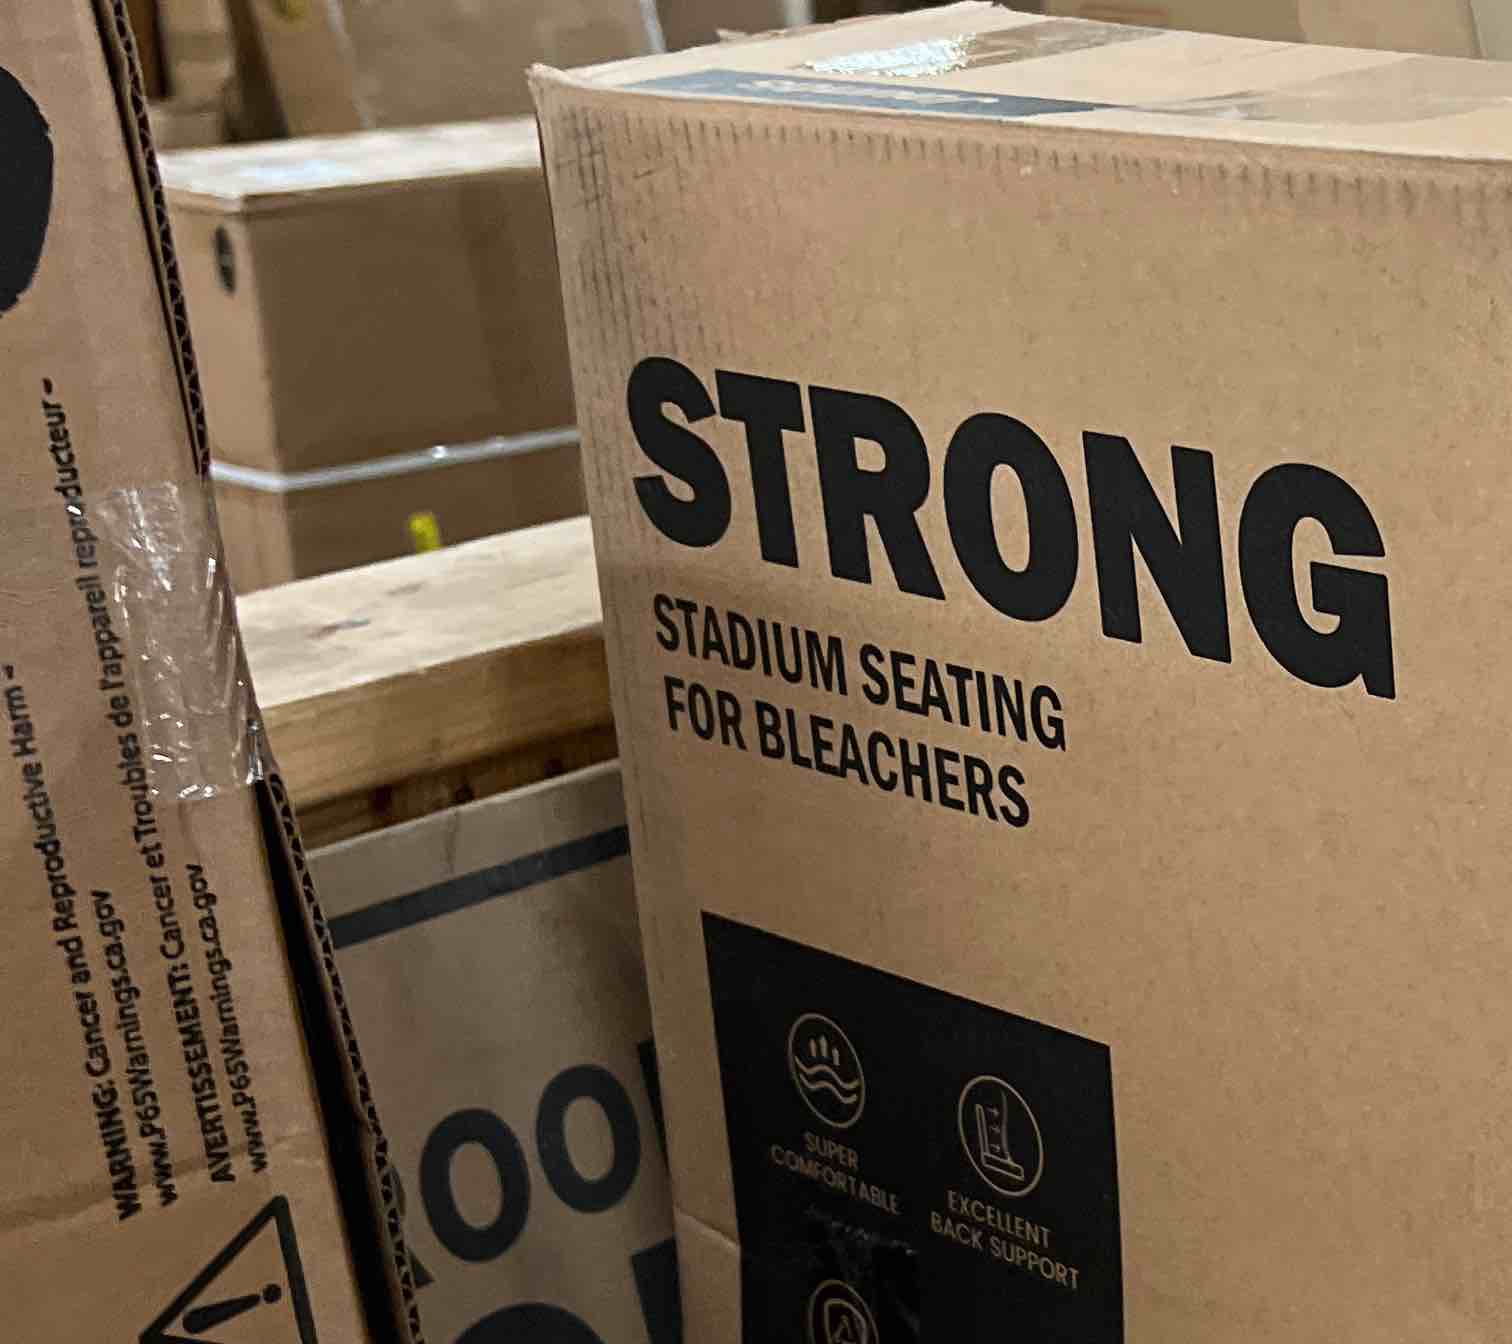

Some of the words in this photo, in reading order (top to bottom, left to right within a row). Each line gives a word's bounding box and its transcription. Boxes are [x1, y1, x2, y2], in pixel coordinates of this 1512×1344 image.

[41, 398, 99, 570] reproducteur
[625, 355, 1397, 700] STRONG
[2, 685, 38, 758] Harm
[105, 694, 135, 730] de
[653, 592, 848, 697] STADIUM
[860, 642, 1067, 753] SEATING
[117, 733, 158, 843] Troubles
[664, 676, 746, 748] FOR
[755, 703, 1031, 829] BLEACHERS
[22, 759, 78, 933] Reproductive
[139, 840, 166, 871] et
[57, 934, 92, 987] and
[149, 873, 186, 961] Cancer
[75, 990, 112, 1079] Cancer
[90, 888, 179, 1208] www.P65Warnings.ca.gov
[185, 862, 269, 1174] www.P65Warnings.ca.gov
[166, 965, 236, 1184] AVERTISSEMENT:
[91, 1080, 142, 1222] WARNING:
[769, 1143, 901, 1217] COMFORTABLE
[803, 1130, 860, 1170] SUPER
[929, 1211, 983, 1250] BACK
[988, 1234, 1081, 1293] SUPPORT
[946, 1188, 1052, 1250] EXCELLENT
